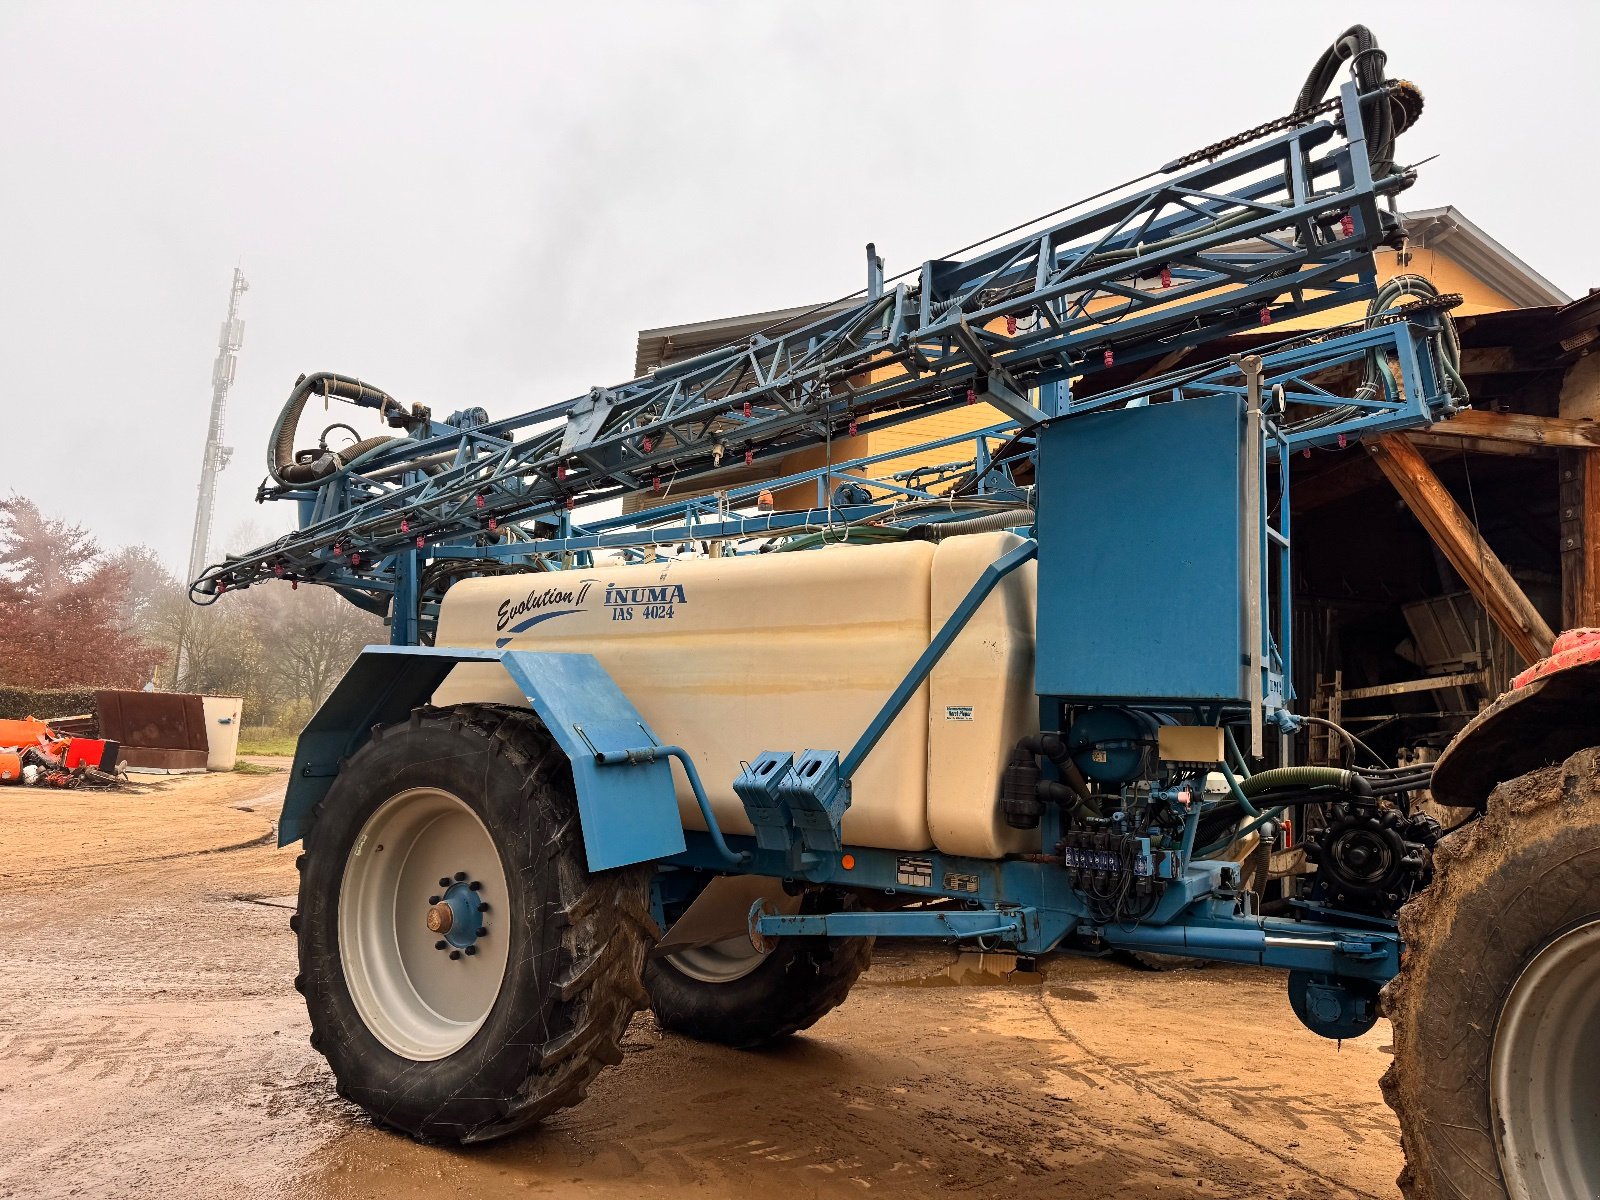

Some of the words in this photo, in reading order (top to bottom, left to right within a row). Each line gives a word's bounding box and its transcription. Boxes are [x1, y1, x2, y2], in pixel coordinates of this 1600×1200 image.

[496, 588, 574, 631] Evolution
[612, 607, 633, 621] IAS
[642, 605, 675, 619] 4024
